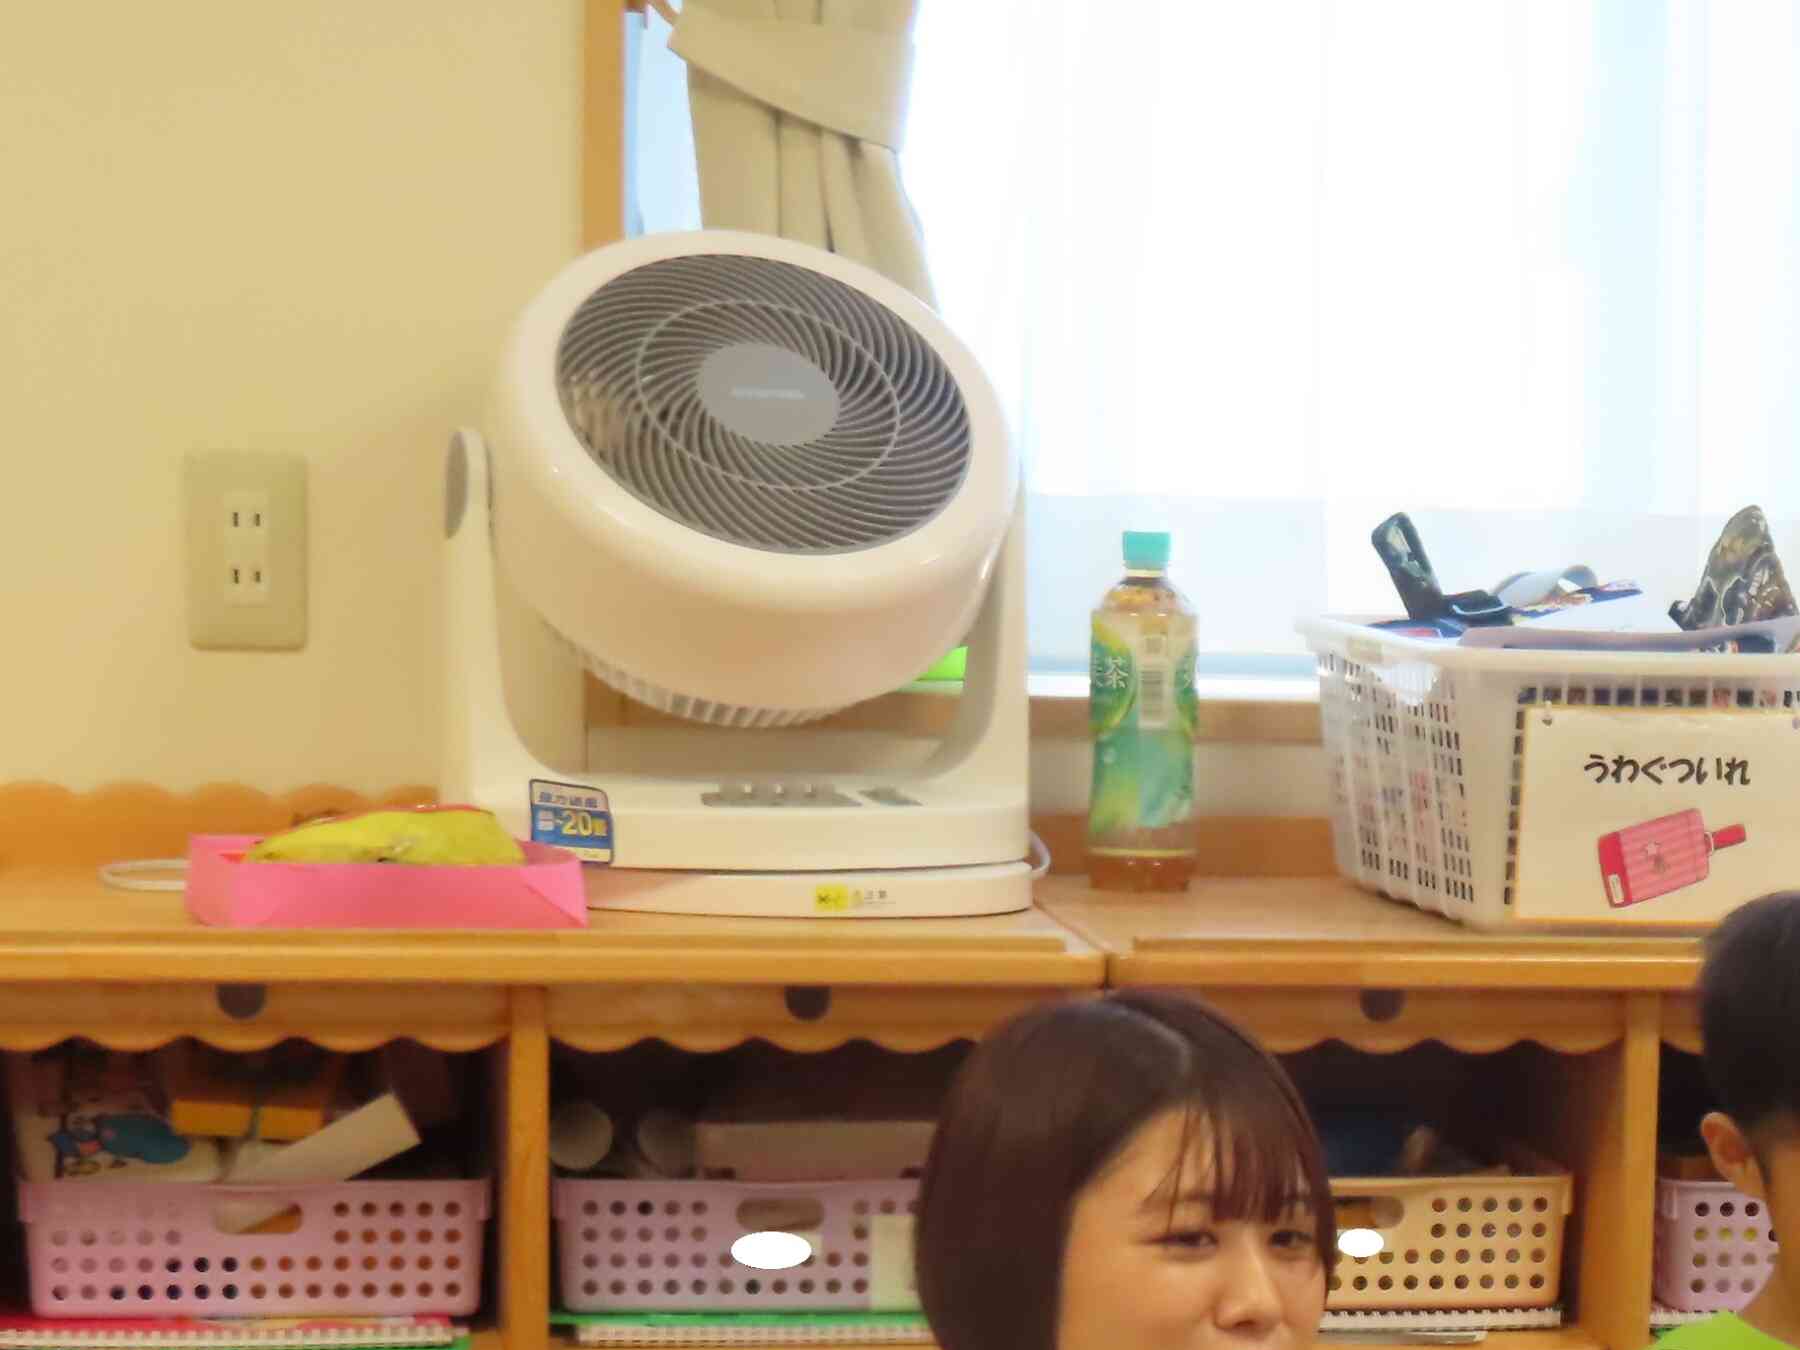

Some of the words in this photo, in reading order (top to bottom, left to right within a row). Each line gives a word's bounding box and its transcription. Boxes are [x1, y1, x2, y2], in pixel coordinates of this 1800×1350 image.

[1583, 753, 1752, 785] うわぐついれ
